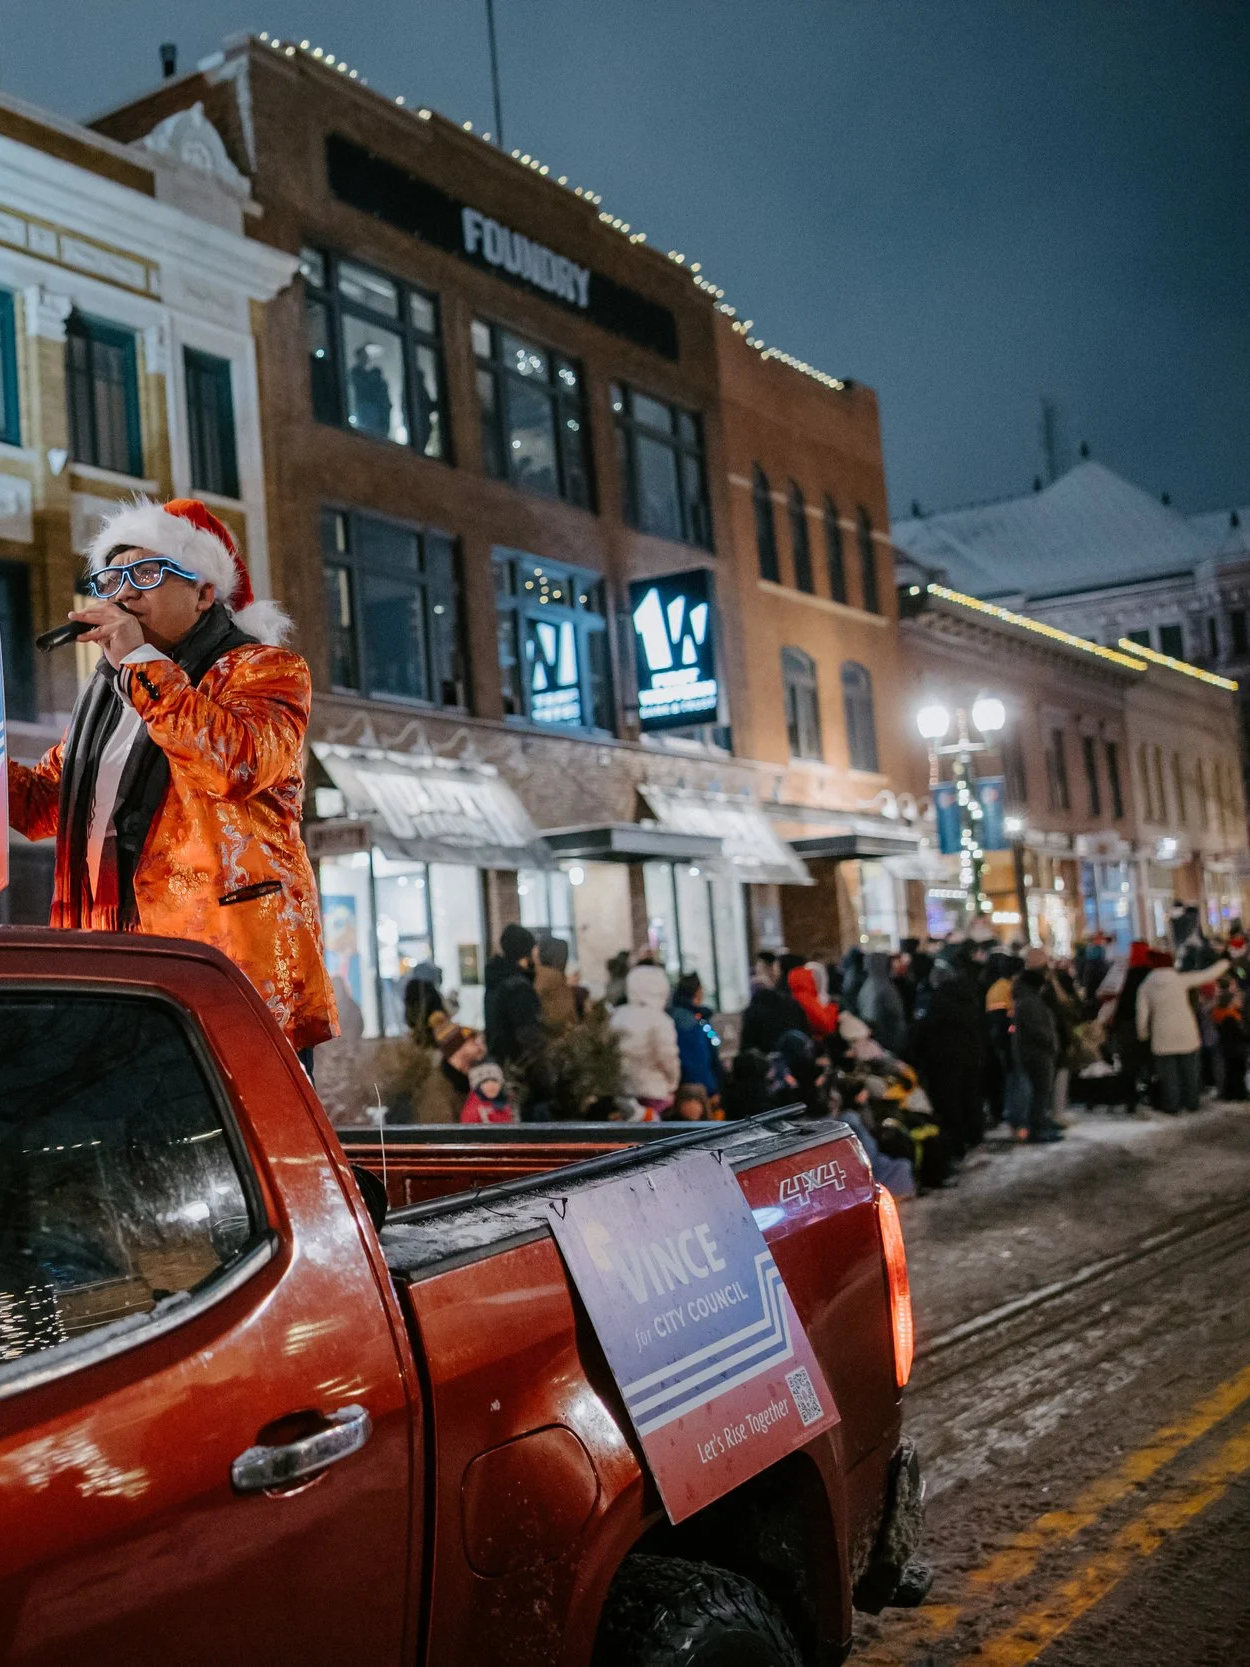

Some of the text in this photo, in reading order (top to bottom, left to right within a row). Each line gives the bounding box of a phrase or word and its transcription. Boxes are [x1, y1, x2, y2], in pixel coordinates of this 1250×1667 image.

[461, 206, 591, 309] FOUNDRY
[607, 1223, 727, 1304] VINCE
[635, 1281, 749, 1352] for CITY COUNCIL
[697, 1435, 725, 1464] Let's
[724, 1424, 748, 1449] Rise
[745, 1398, 790, 1434] Together
